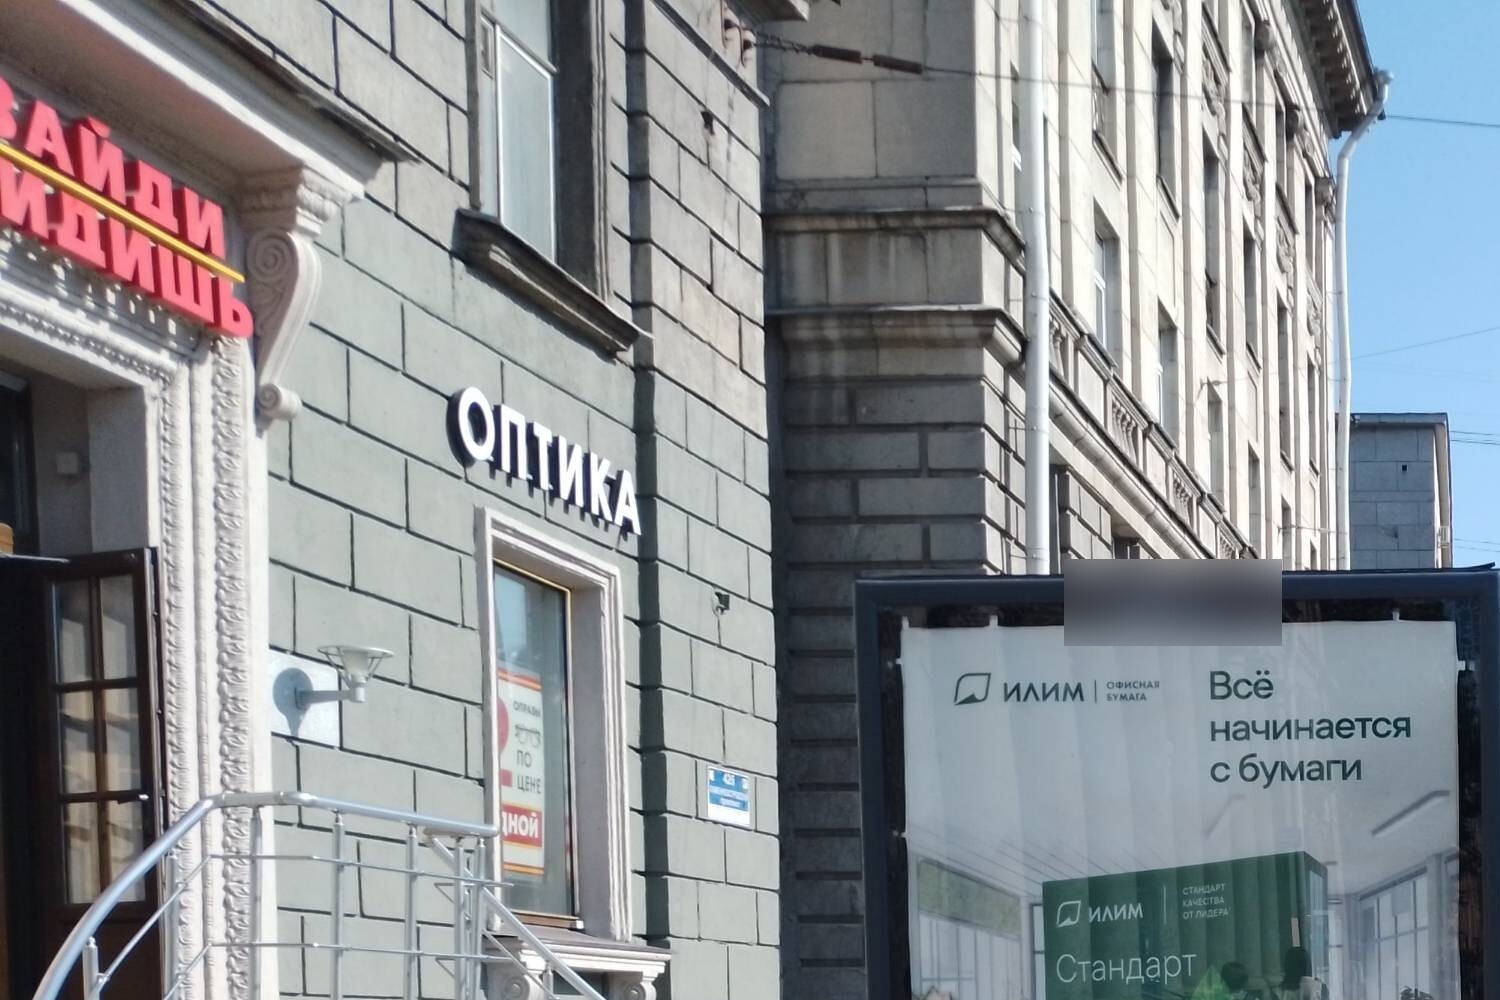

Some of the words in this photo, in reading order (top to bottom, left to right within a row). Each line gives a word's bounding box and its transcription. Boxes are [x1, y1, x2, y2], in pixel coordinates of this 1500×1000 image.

[456, 386, 641, 536] ОПТИКА
[1003, 682, 1085, 702] ИЛИМ
[1106, 681, 1160, 690] ОФИСНАЯ
[1209, 670, 1274, 700] Всё
[1106, 693, 1147, 701] БУМАГА
[1210, 716, 1412, 741] начинается
[516, 750, 532, 768] ПО
[1210, 761, 1231, 783] с
[1238, 753, 1362, 789] бумаги
[517, 774, 541, 794] ЦЕНЕ
[1182, 882, 1226, 896] СТАНДАРТ
[1182, 896, 1225, 908] КАЧЕСТВА
[1089, 902, 1143, 923] ИЛИМ
[1056, 953, 1198, 985] Стандарт
